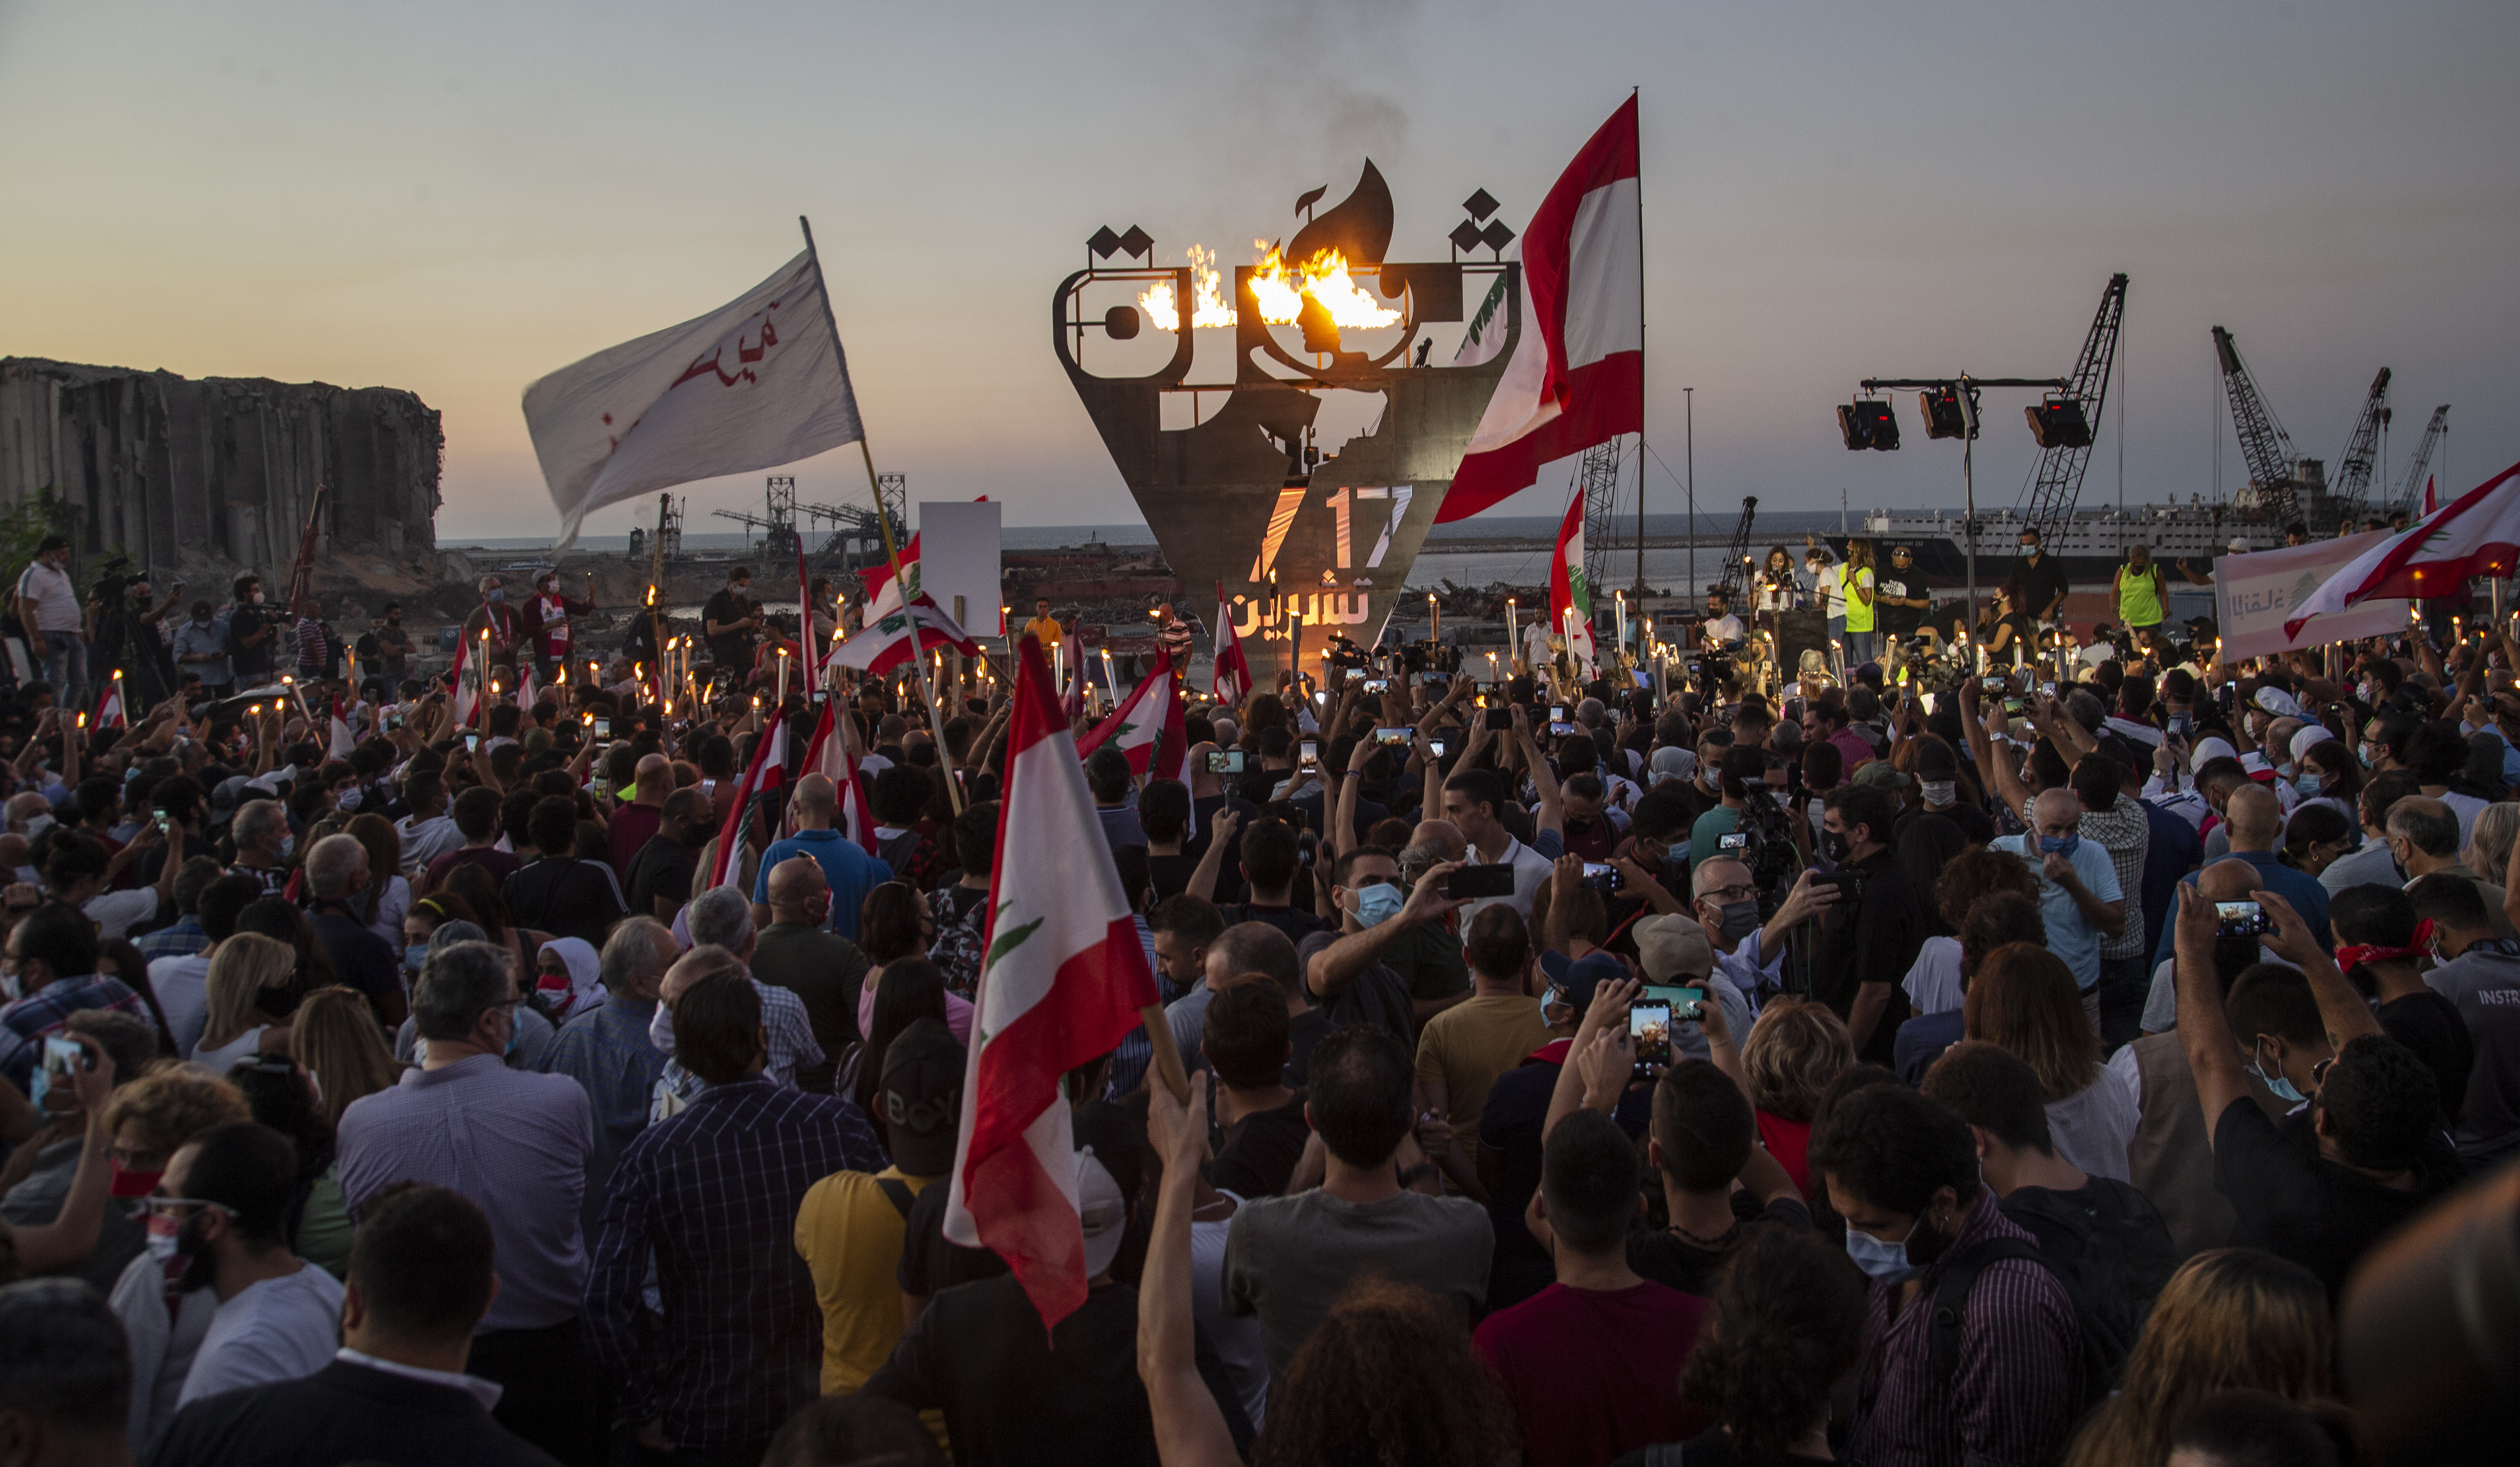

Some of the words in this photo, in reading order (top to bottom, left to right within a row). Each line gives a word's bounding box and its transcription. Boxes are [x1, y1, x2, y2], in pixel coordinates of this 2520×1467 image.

[1326, 485, 1412, 568] 17
[1227, 568, 1373, 641] تشرين
[2478, 989, 2520, 1005] INSTR
